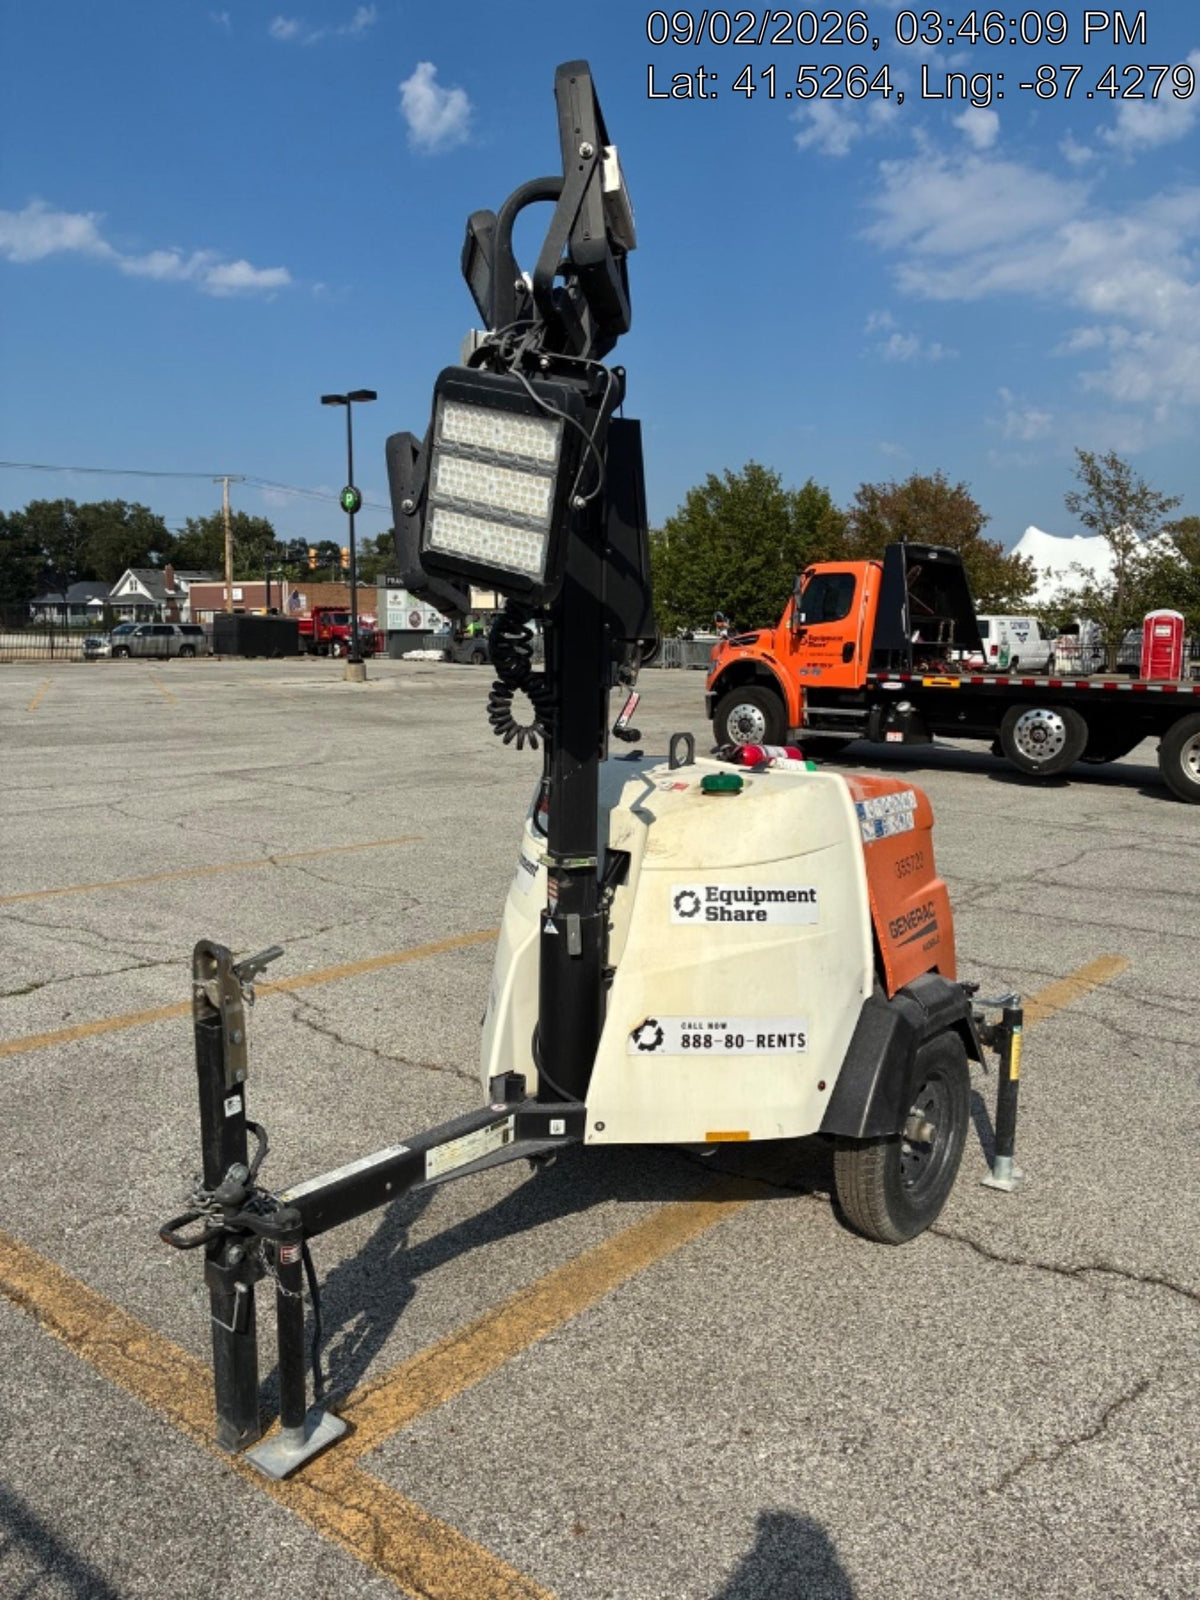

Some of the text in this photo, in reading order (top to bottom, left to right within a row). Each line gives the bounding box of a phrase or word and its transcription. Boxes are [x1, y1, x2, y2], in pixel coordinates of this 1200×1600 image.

[346, 494, 353, 506] P
[705, 886, 817, 905] Equipment
[705, 906, 767, 922] Share
[680, 1022, 727, 1030] CALL NOW
[680, 1033, 806, 1049] 888-80-RENTS
